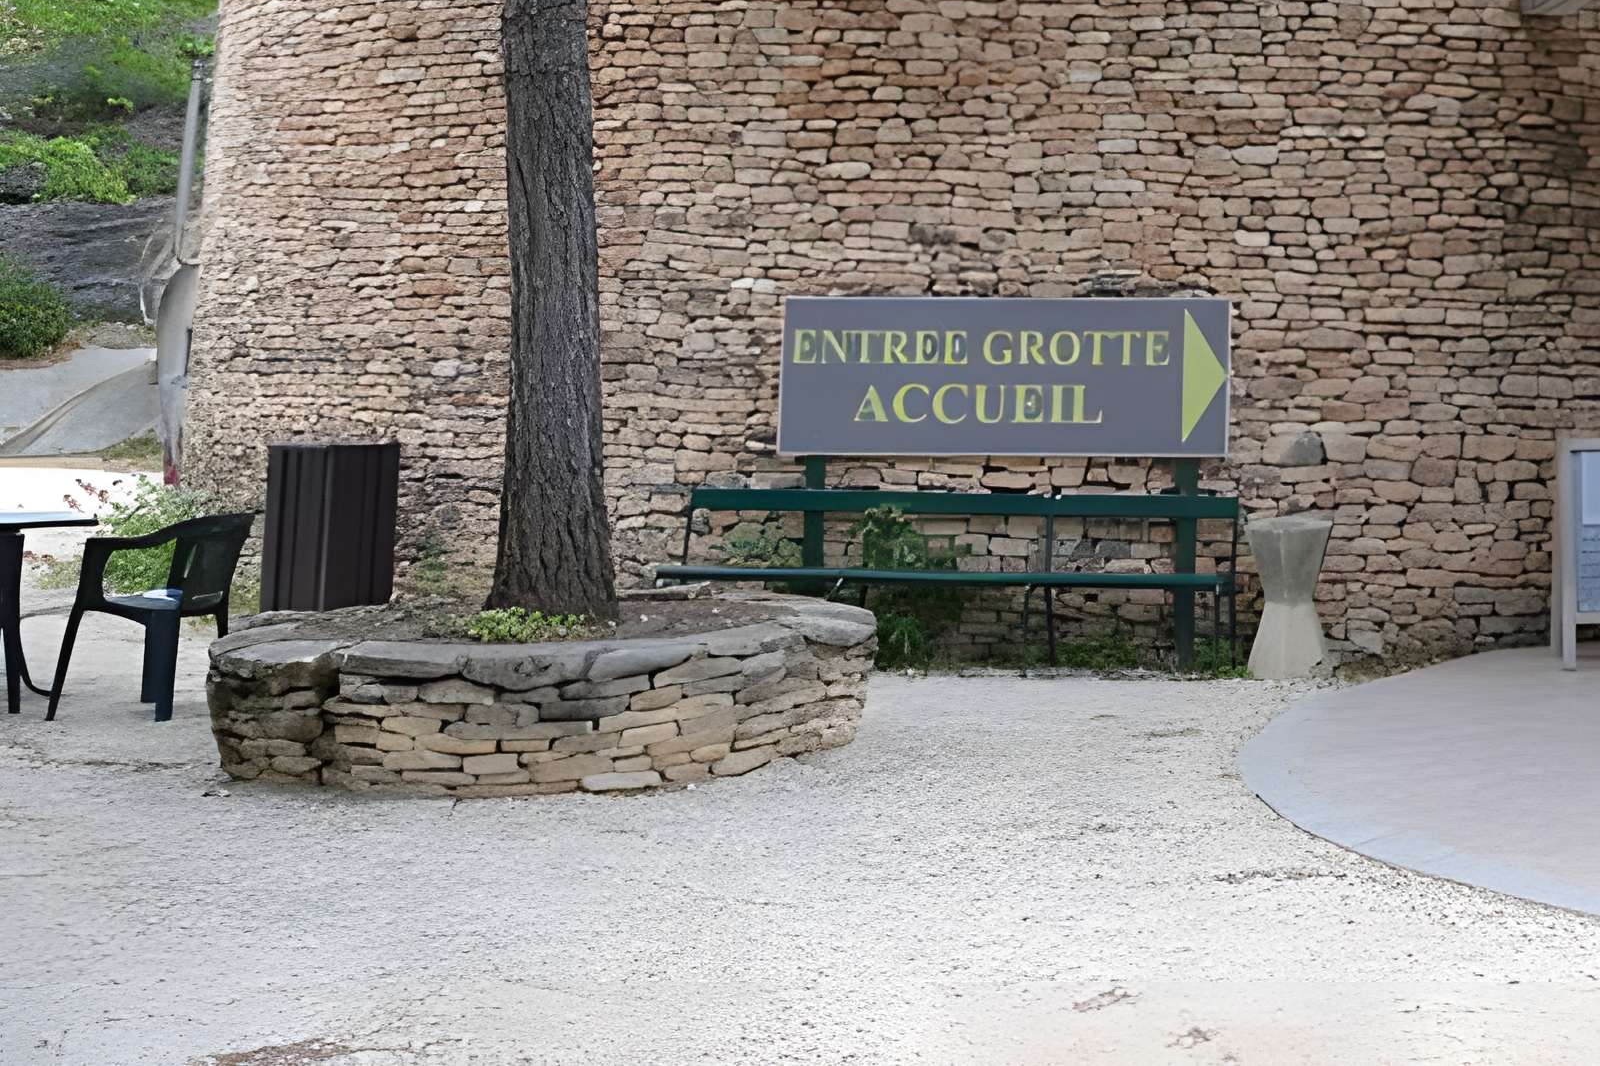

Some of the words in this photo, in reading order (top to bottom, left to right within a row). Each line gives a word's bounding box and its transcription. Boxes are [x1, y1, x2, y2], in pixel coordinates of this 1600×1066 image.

[793, 329, 968, 365] ENTREE
[983, 330, 1170, 366] GROTTE
[853, 383, 1103, 424] ACCUEIL
